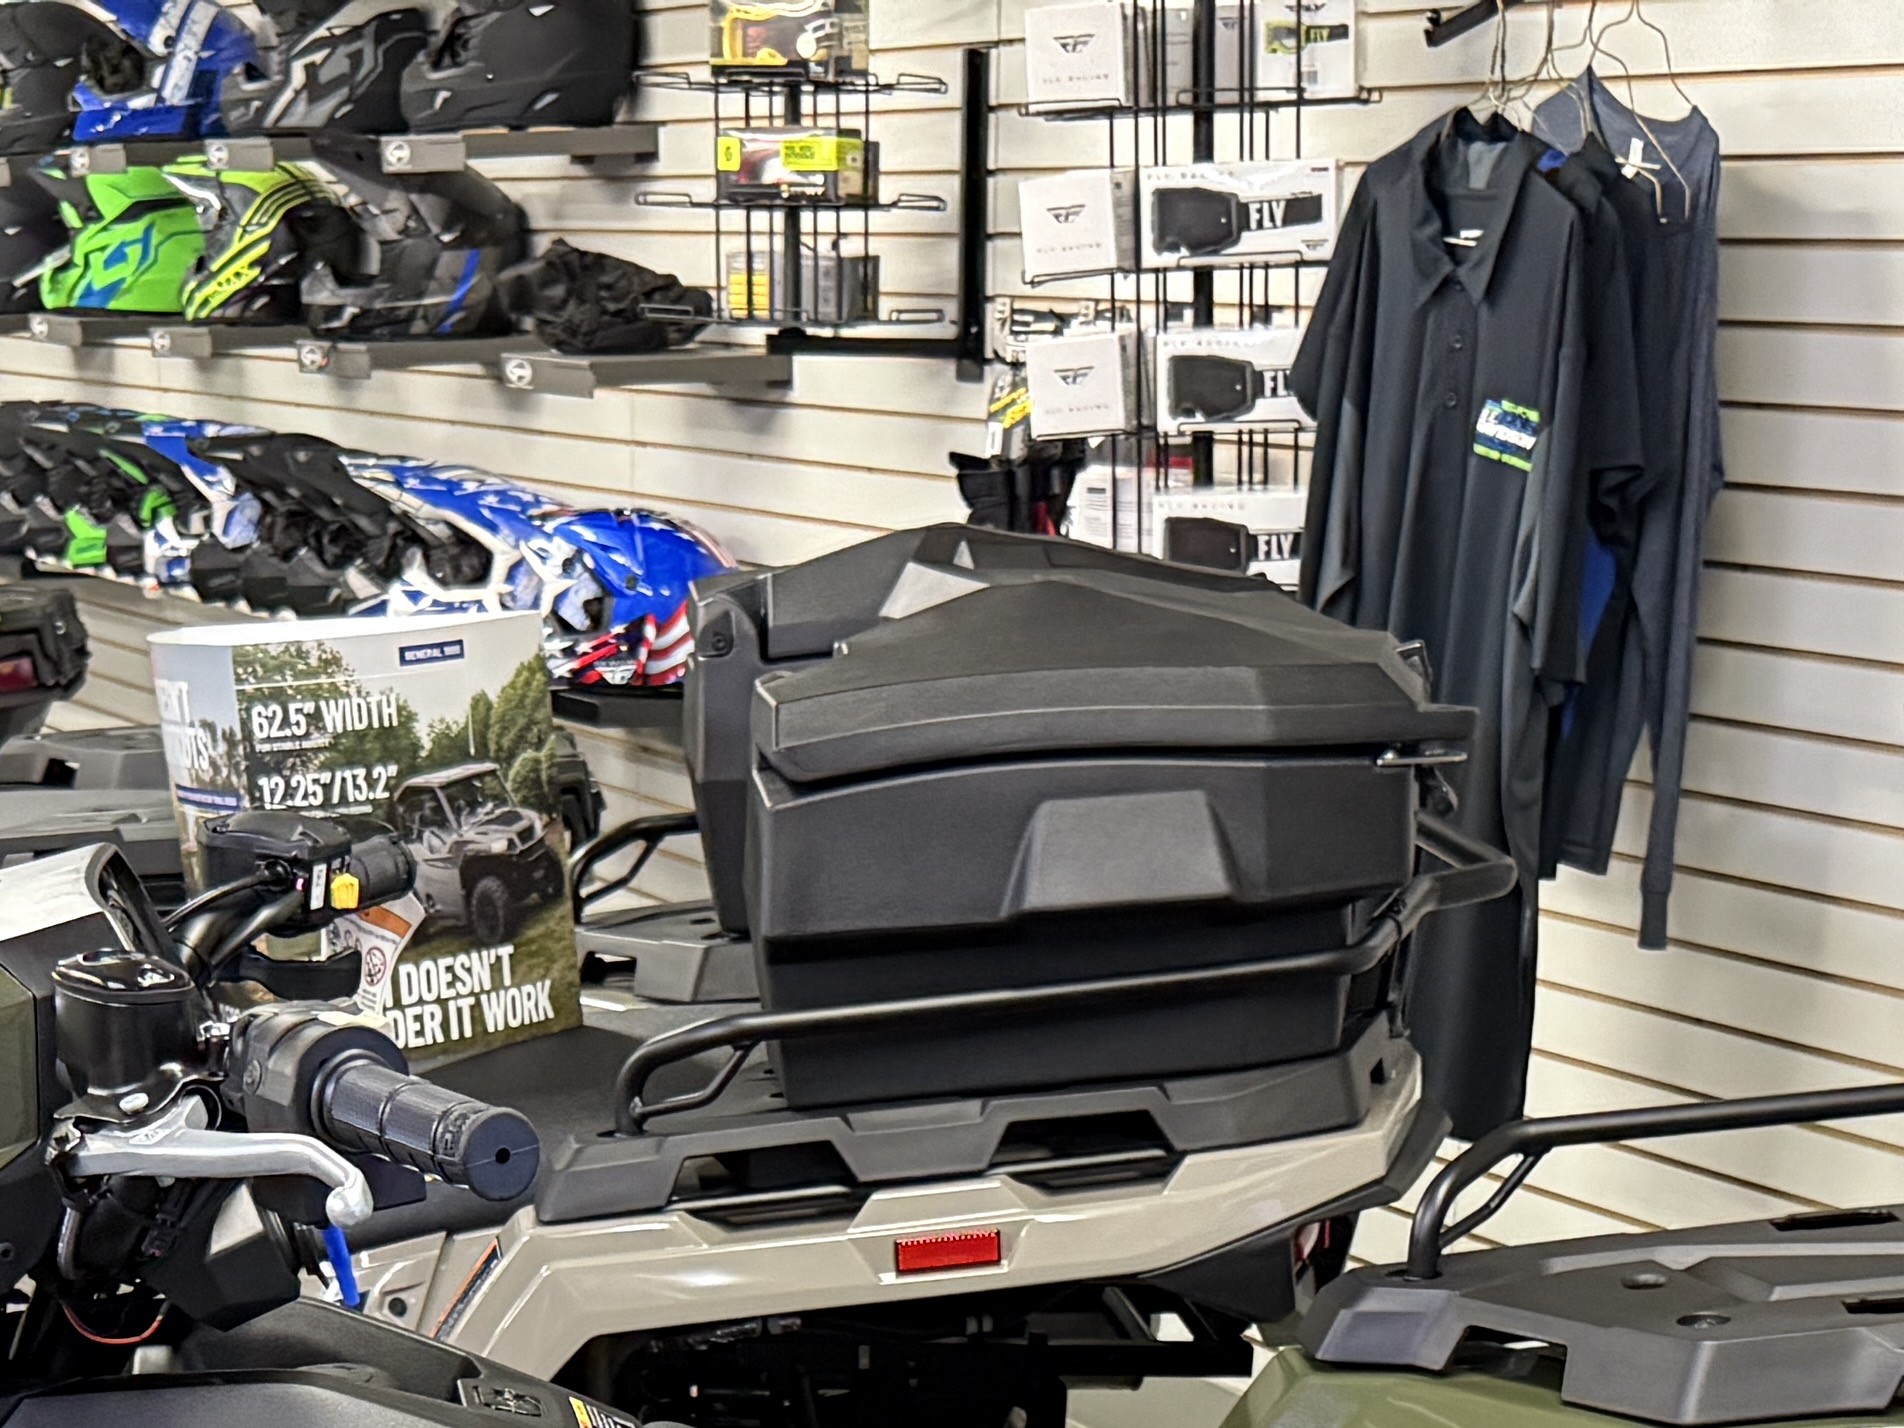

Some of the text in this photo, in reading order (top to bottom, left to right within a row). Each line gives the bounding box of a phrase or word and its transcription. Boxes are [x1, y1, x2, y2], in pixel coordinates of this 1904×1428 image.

[1249, 200, 1286, 232] FLY
[1257, 534, 1294, 561] FLY
[251, 693, 398, 739] 62.5" WIDTH
[257, 764, 399, 810] 12.25"/13.2"
[398, 945, 514, 1007] DOESN'T
[448, 996, 476, 1041] IT
[480, 979, 555, 1034] WORK
